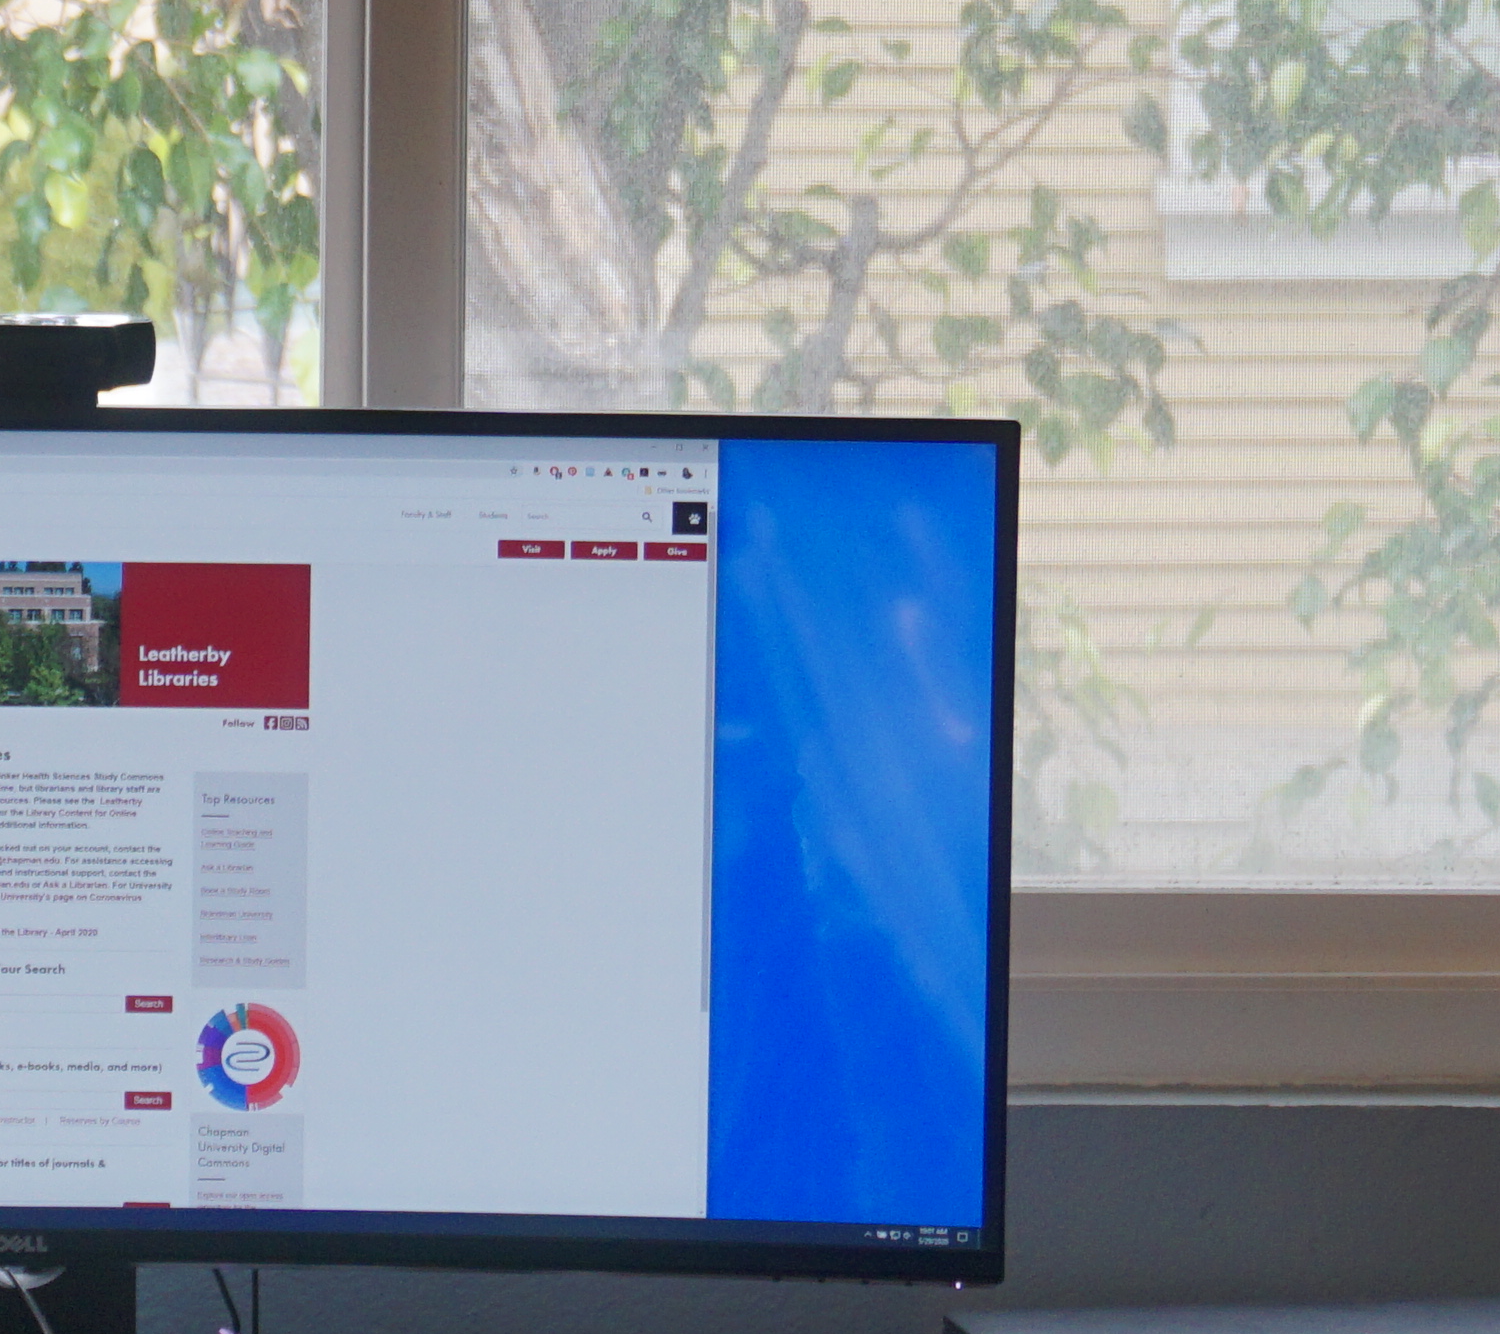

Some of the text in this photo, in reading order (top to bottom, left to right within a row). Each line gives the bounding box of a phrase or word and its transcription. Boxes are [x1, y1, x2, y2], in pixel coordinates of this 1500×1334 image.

[522, 544, 541, 553] Visit
[591, 546, 617, 558] Apply
[667, 547, 687, 555] Give
[138, 646, 231, 666] Leatherby
[138, 670, 218, 686] Libraries
[222, 719, 255, 727] Follow
[21, 772, 50, 780] Health
[52, 772, 91, 780] Sciences
[93, 772, 118, 782] Study
[120, 773, 164, 781] Commons
[202, 793, 275, 805] Top Resources
[25, 809, 56, 818] Library
[58, 809, 93, 817] Content
[94, 809, 107, 817] for
[108, 809, 137, 817] Online
[1, 928, 15, 936] the
[17, 928, 47, 937] Library
[55, 928, 76, 938] April
[77, 928, 98, 937] 2020
[24, 964, 65, 974] Search
[134, 999, 164, 1008] Search
[16, 1062, 63, 1072] e-books,
[66, 1062, 103, 1072] media,
[107, 1063, 128, 1071] and
[130, 1063, 162, 1072] more)
[133, 1095, 163, 1105] Search
[197, 1126, 250, 1139] Chapman
[197, 1141, 285, 1156] University Digital
[10, 1159, 36, 1167] titles
[38, 1159, 49, 1167] of
[51, 1159, 95, 1169] journals
[97, 1159, 106, 1168] &
[197, 1157, 250, 1167] Commons
